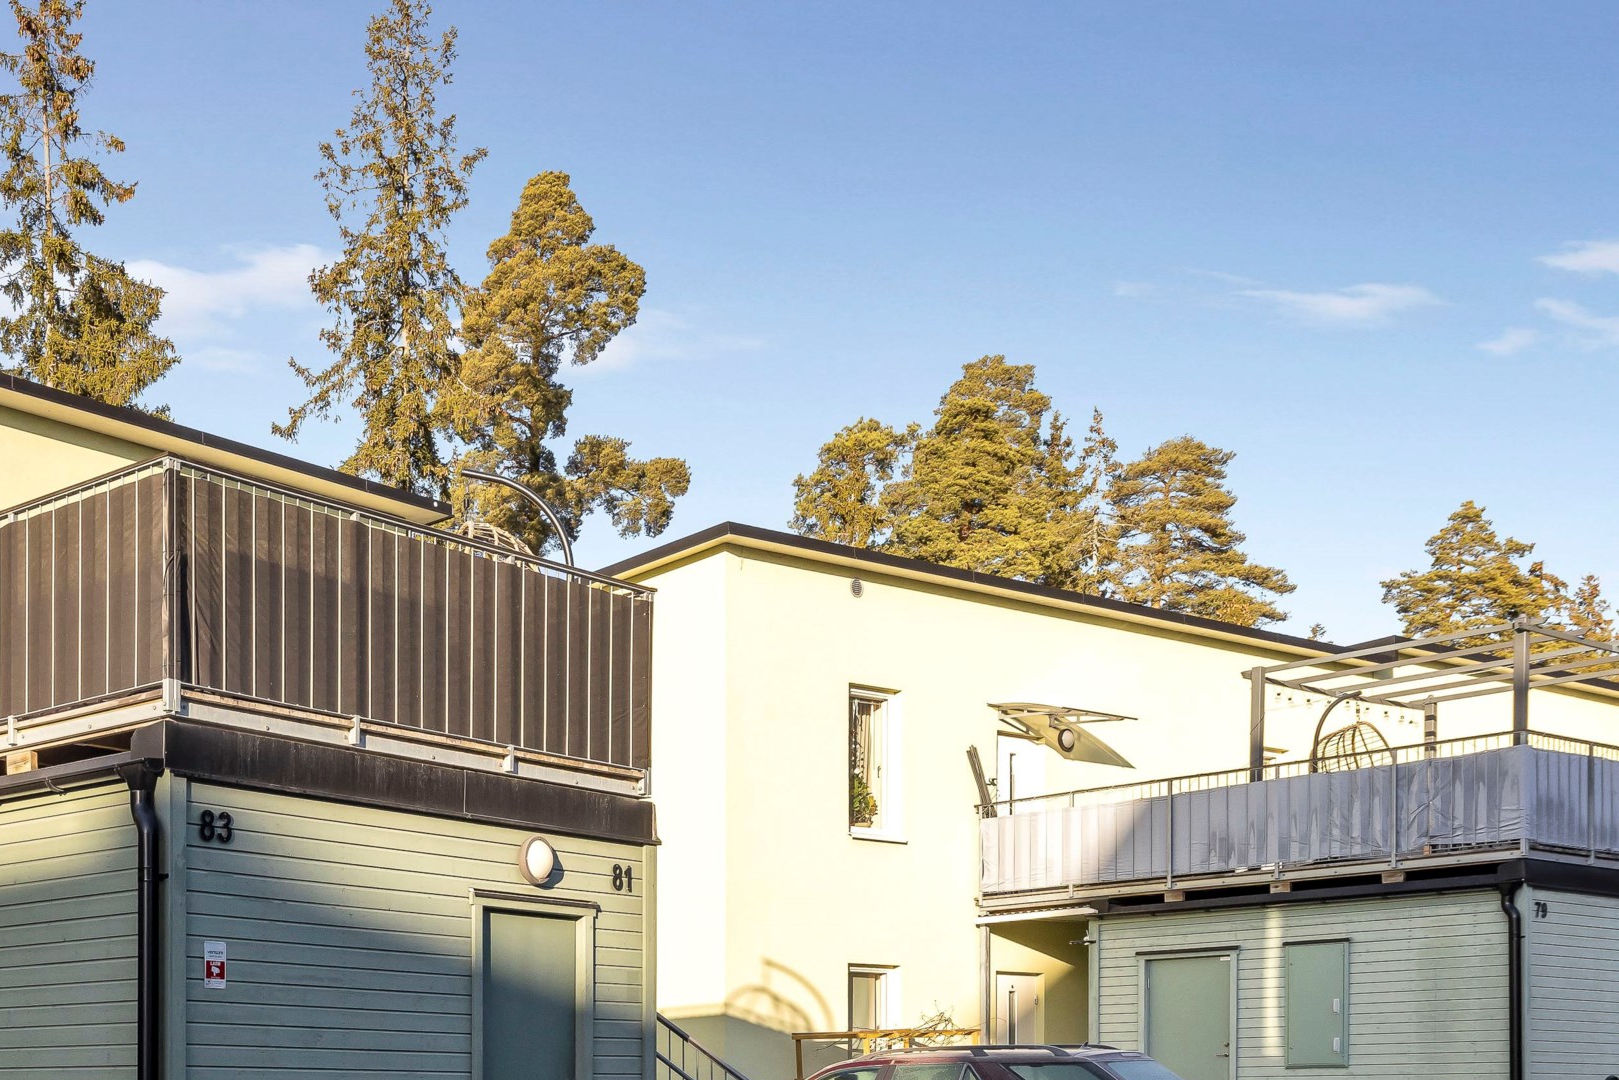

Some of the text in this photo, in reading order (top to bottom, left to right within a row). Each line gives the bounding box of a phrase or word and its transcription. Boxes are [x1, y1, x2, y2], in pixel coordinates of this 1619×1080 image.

[200, 809, 232, 843] 83
[612, 863, 632, 893] 81
[1534, 901, 1547, 918] 79
